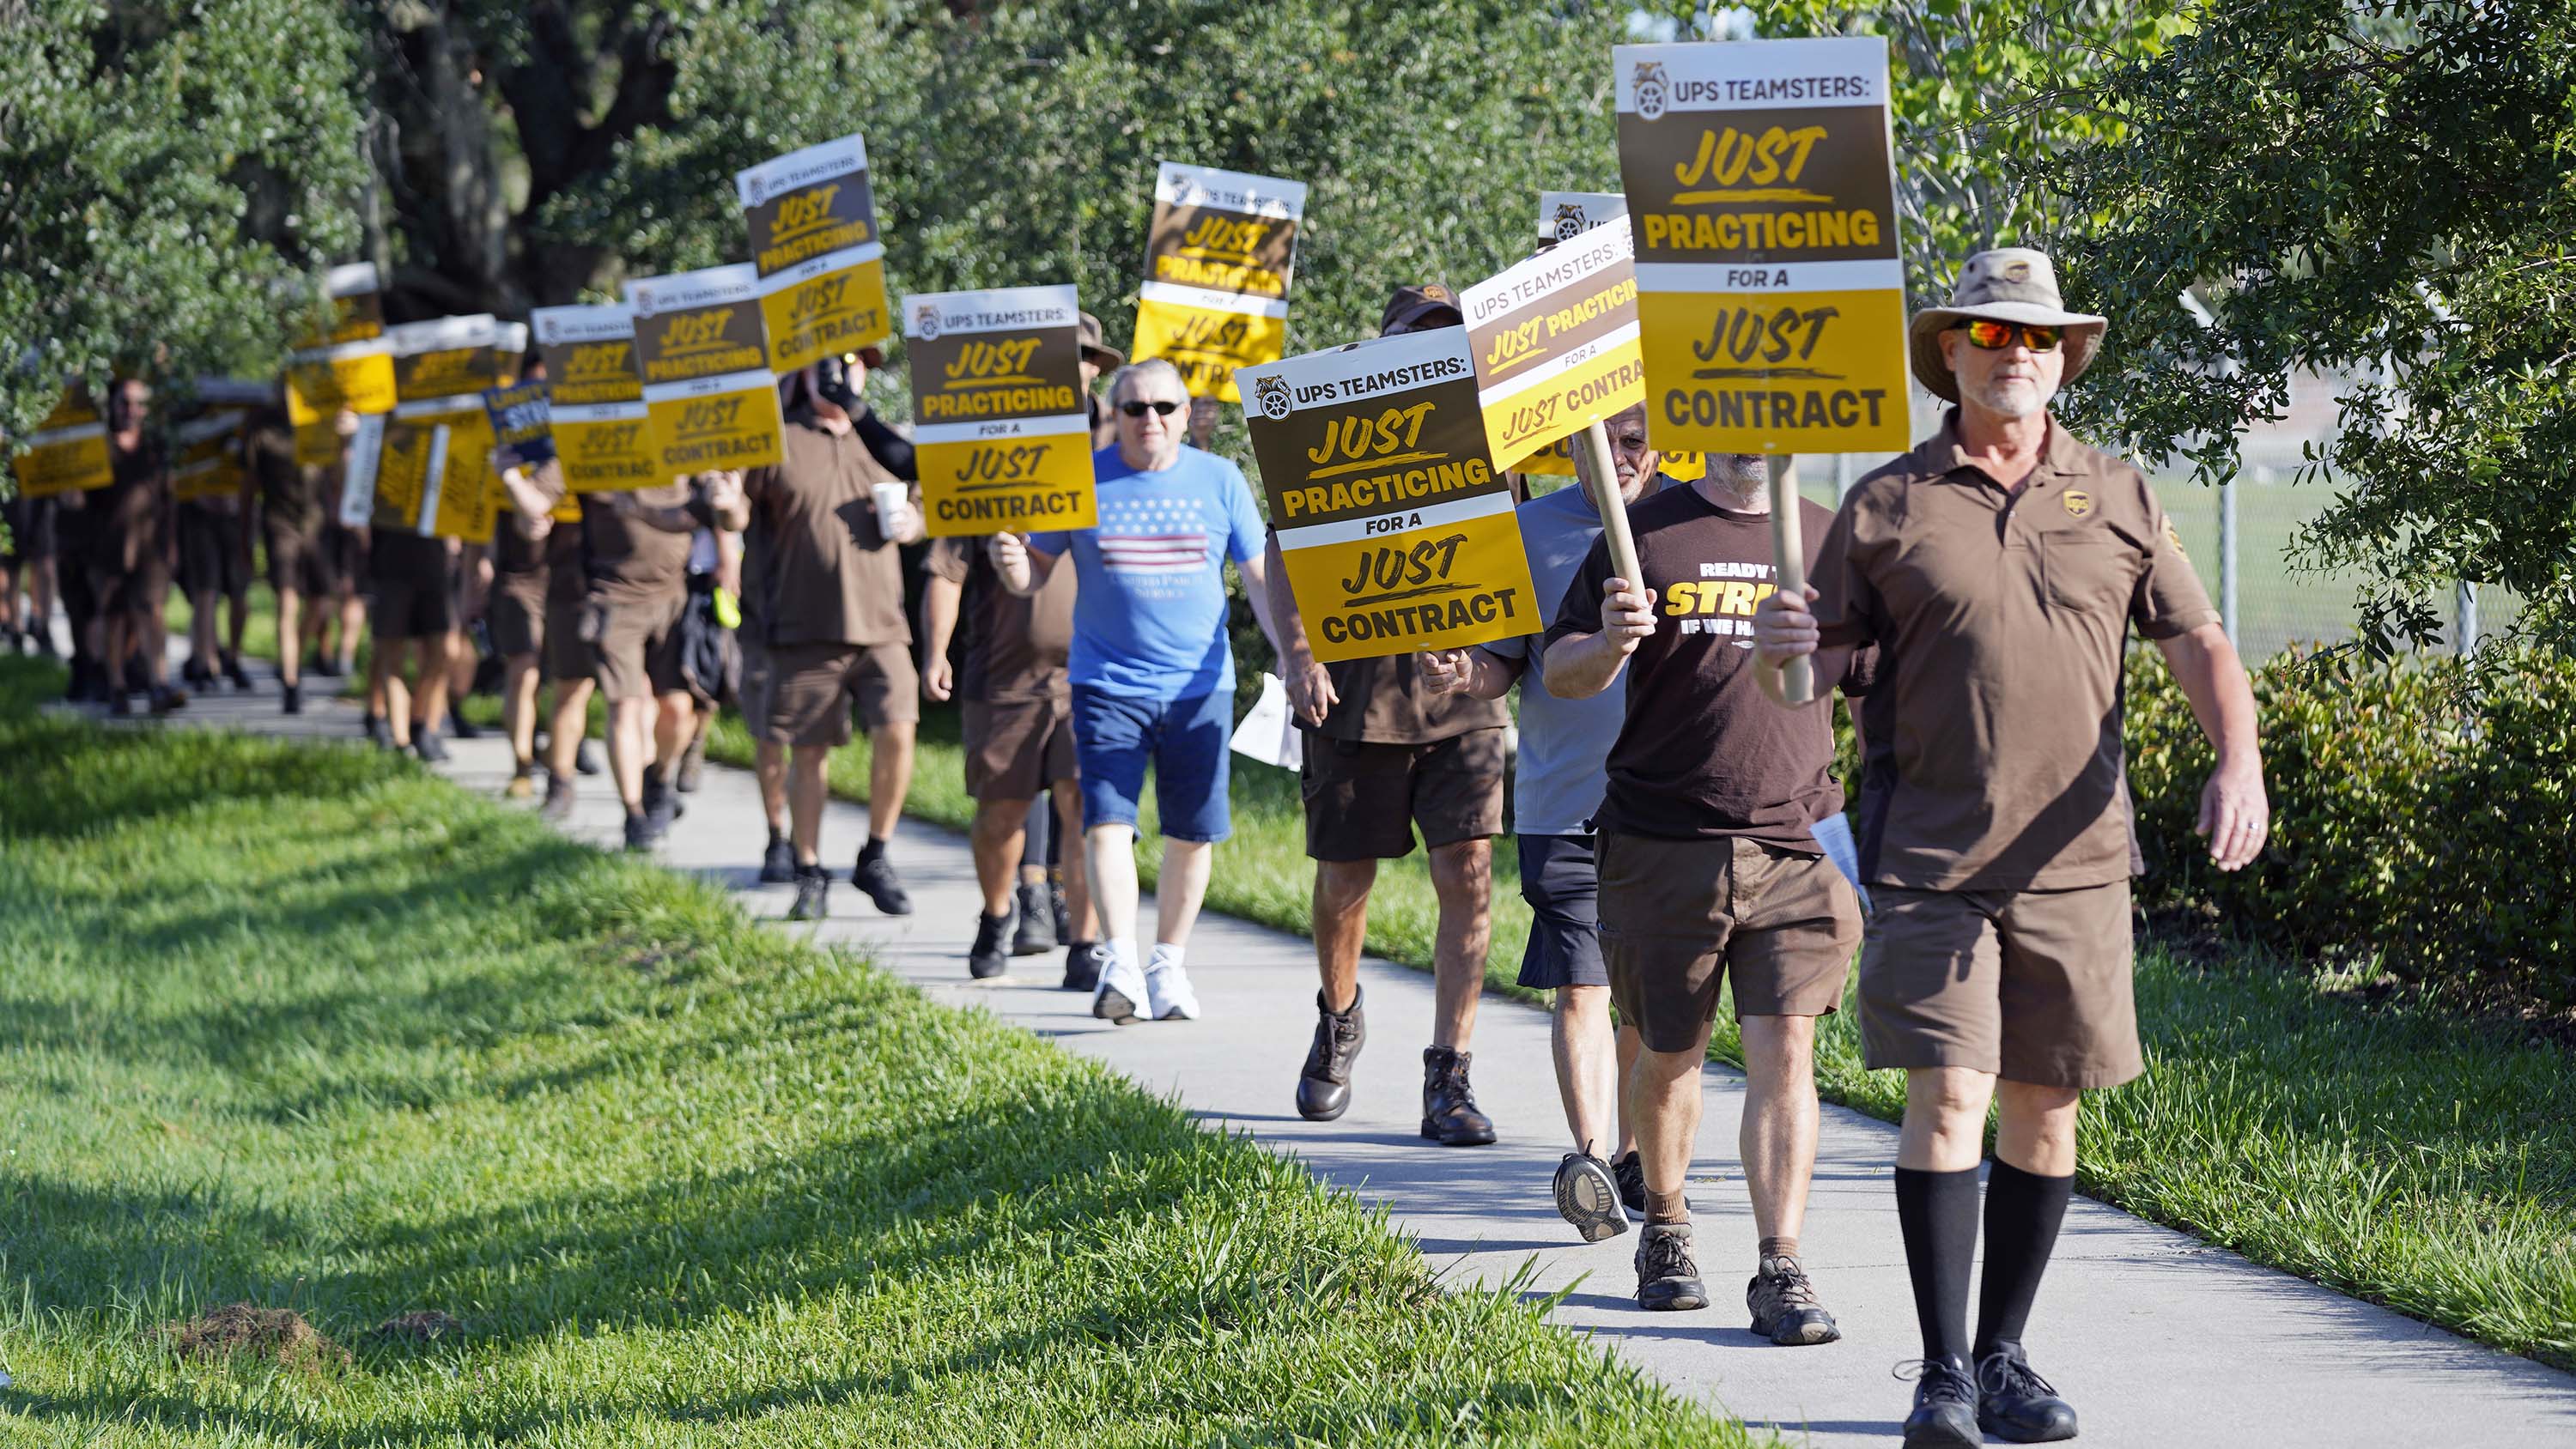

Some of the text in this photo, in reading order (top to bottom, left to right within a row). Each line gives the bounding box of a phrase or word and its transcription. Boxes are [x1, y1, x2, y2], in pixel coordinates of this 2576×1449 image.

[1675, 76, 1870, 102] UPS TEAMSTERS:
[1675, 125, 1827, 187] JUST
[769, 184, 841, 233] JUST
[758, 220, 869, 274] PRACTICING
[1184, 215, 1270, 254] JUST
[1643, 209, 1880, 250] PRACTICING
[788, 273, 854, 320] JUST
[1473, 243, 1619, 320] UPS TEAMSTERS:
[1728, 268, 1789, 288] FOR A
[659, 308, 734, 347] JUST
[778, 308, 878, 359] CONTRACT
[945, 315, 974, 330] UPS
[1173, 315, 1252, 349] JUST
[1486, 278, 1637, 365] JUST PRACTICI
[1692, 306, 1839, 364] JUST
[647, 346, 764, 381] PRACTICING
[945, 336, 1042, 378] JUST
[1564, 345, 1597, 368] FOR A
[1296, 356, 1467, 403] UPS TEAMSTERS:
[1503, 358, 1645, 440] JUST CONTRA
[676, 396, 746, 430] JUST
[922, 385, 1075, 418] PRACTICING
[1665, 389, 1886, 429] CONTRACT
[663, 432, 772, 465] CONTRACT
[979, 423, 1022, 436] FOR A
[1307, 401, 1436, 464] JUST
[569, 460, 656, 481] CONTRAC
[957, 444, 1052, 482] JUST
[937, 491, 1082, 521] CONTRACT
[1282, 458, 1492, 518] PRACTICING
[1366, 512, 1423, 536] FOR A
[1342, 533, 1467, 595] JUST
[1699, 562, 1770, 579] READY
[1322, 588, 1516, 644] CONTRACT
[1665, 580, 1778, 616] STRI
[1680, 619, 1701, 634] IF
[1703, 619, 1734, 635] WE
